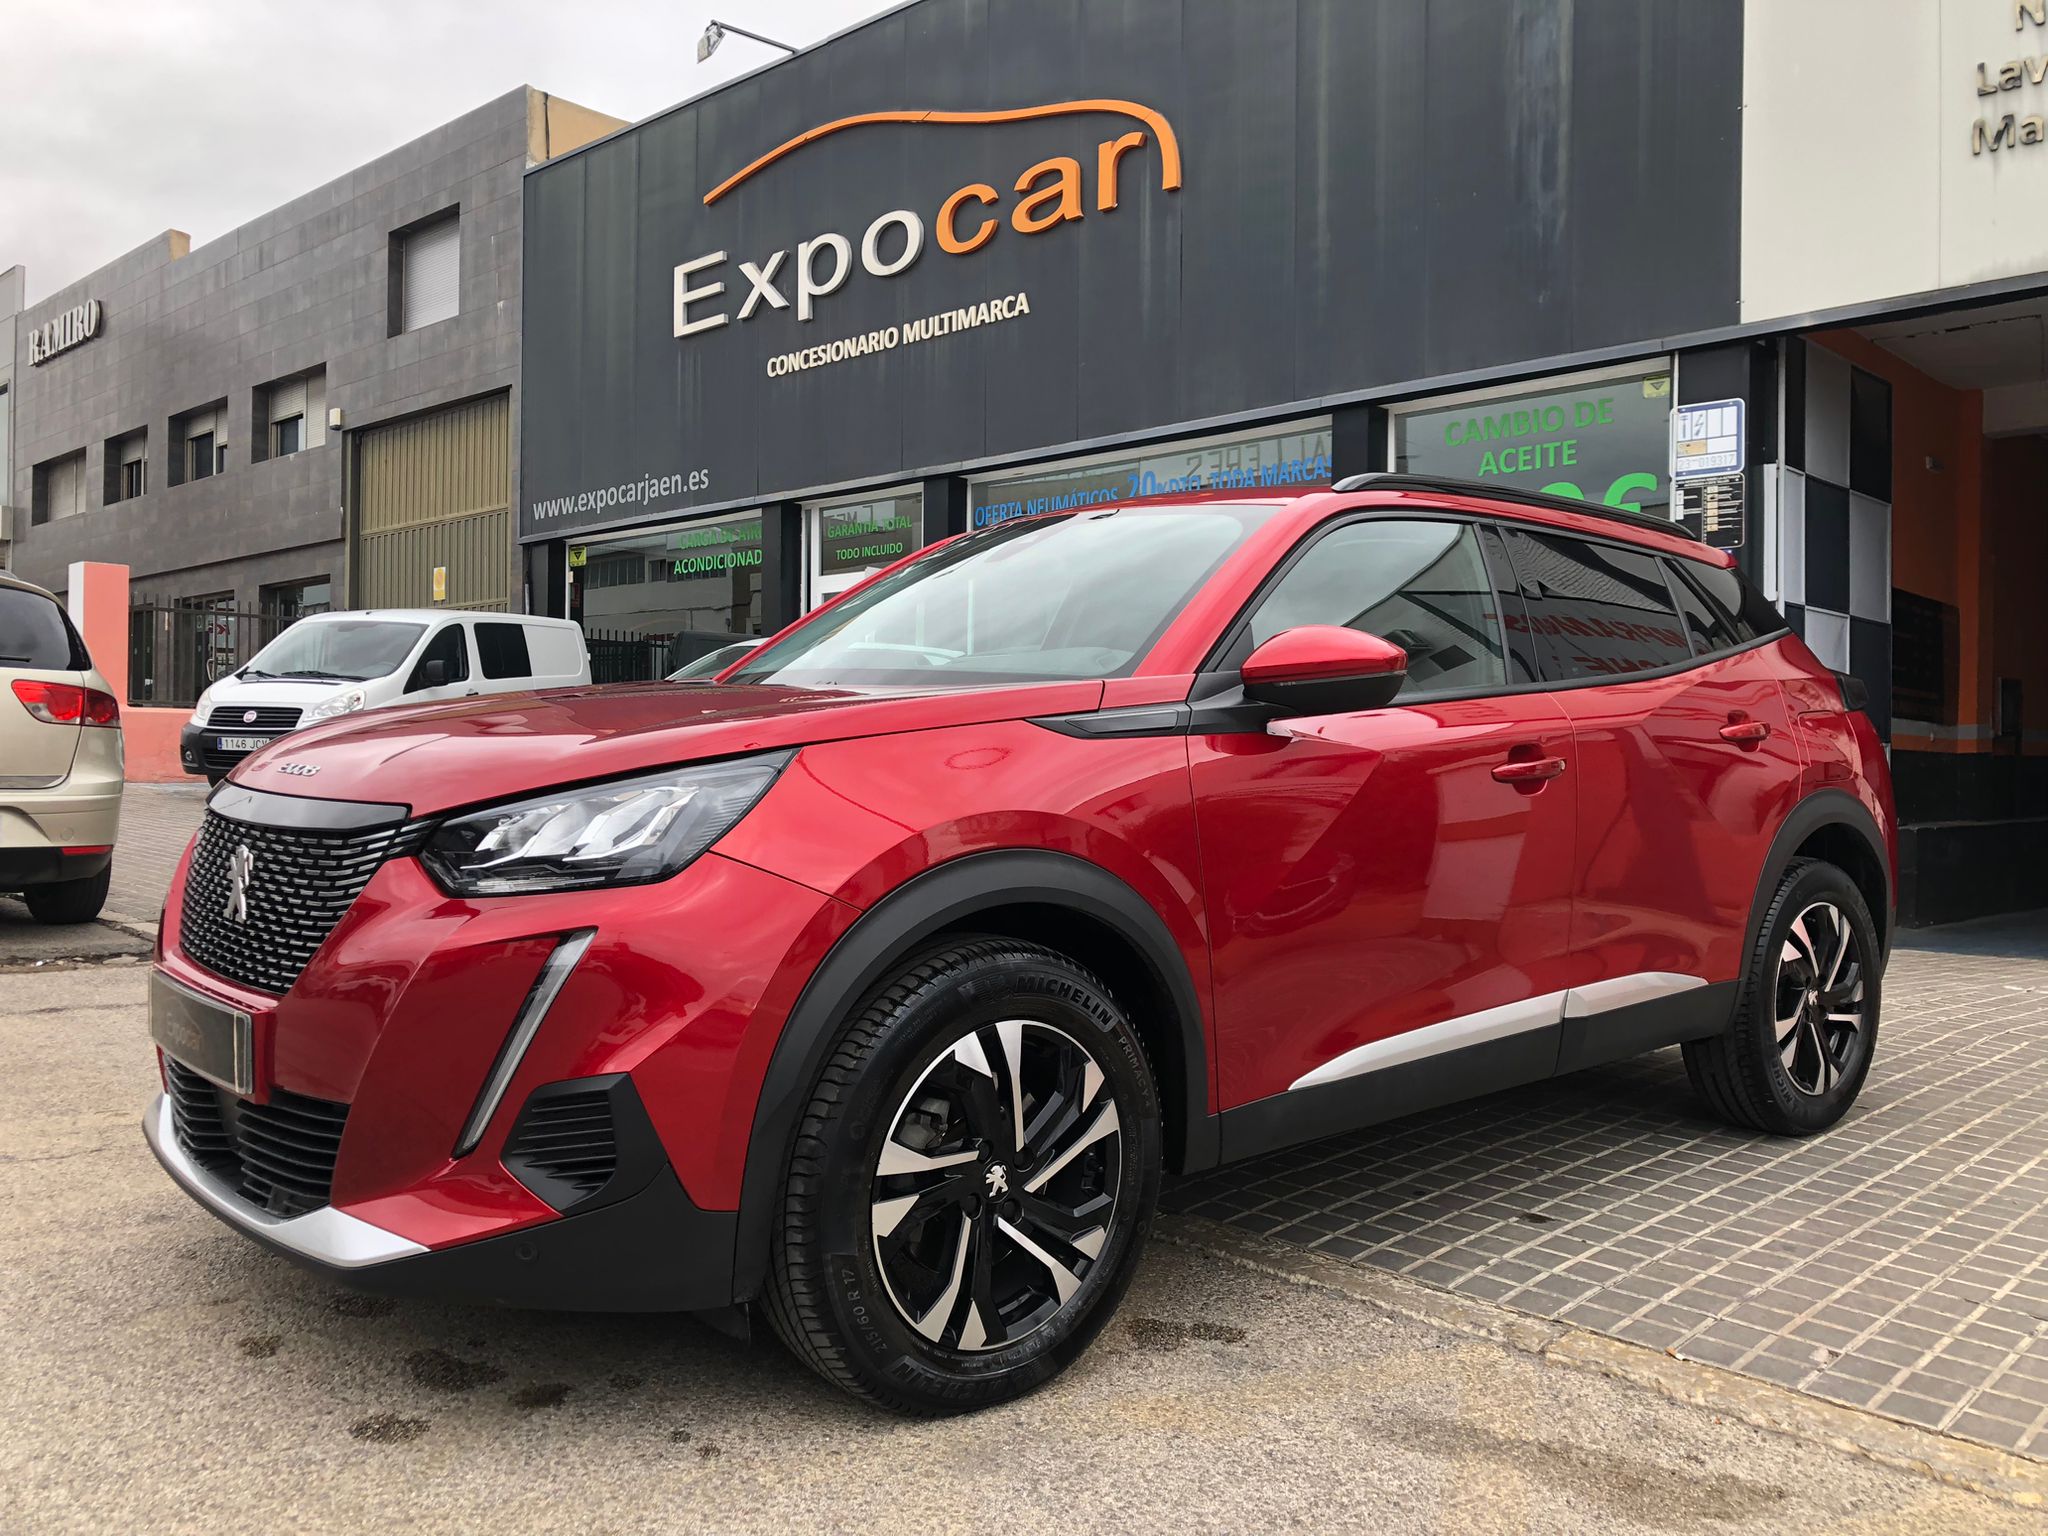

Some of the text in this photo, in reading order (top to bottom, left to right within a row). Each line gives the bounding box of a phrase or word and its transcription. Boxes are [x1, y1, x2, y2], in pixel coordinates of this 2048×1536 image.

[672, 130, 1148, 339] Expocar
[28, 298, 98, 366] RAMIRO
[767, 292, 1030, 378] CONCESIONARIO MULTIMARCA
[1444, 397, 1615, 447] CAMBIO DE
[1478, 439, 1578, 477] ACEITE
[533, 467, 710, 520] www.expocarjaen.es
[975, 502, 1024, 527] OFERTA
[1211, 468, 1256, 490] TODA
[836, 542, 903, 561] TODO INCLUIDO
[225, 739, 247, 749] 1146
[1016, 975, 1113, 1027] MICHELIN
[1118, 1035, 1150, 1096] PRIMACY
